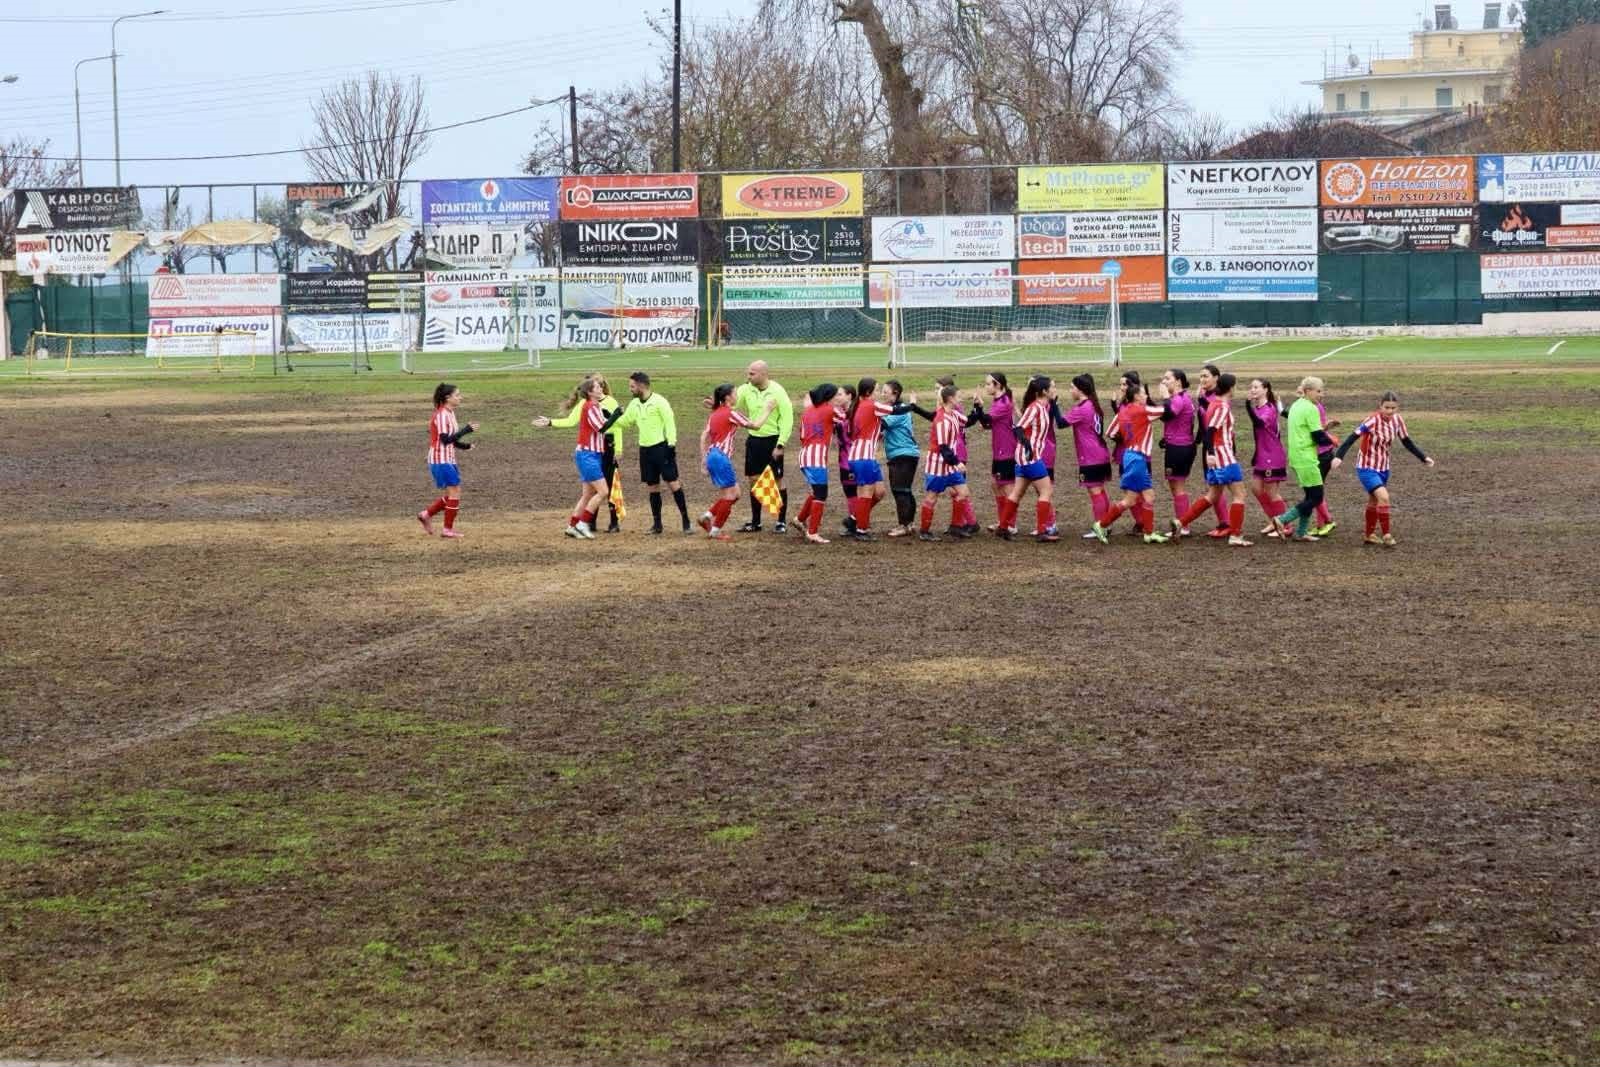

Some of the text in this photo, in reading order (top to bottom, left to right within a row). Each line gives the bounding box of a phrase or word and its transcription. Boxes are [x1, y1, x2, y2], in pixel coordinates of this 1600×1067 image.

[1190, 166, 1314, 183] ΝΕΓΚΟΓΛΟΥ
[1370, 159, 1468, 180] Horizon
[1047, 170, 1151, 187] MrPhone.gr
[596, 190, 691, 200] ΔΙΑΚΡΟΤΗΜΑ
[752, 186, 836, 200] X-TREME
[1400, 192, 1425, 201] 2510
[1429, 192, 1468, 201] 223122
[499, 201, 550, 212] ΔΗΜΗΤΡΗΣ
[1323, 209, 1365, 222] EVAN
[1395, 208, 1473, 218] ΜΠΑΞΕΒΑΝΙΔΗ
[578, 222, 678, 241] INIKON
[46, 234, 111, 253] ΤΟΥΝΟΥΣ
[580, 243, 679, 253] ΕΜΠΟΡΙΑ ΣΙΔΗΡΟΥ
[725, 225, 820, 261] Prestige
[1025, 241, 1064, 254] tech
[1097, 244, 1121, 253] 2510
[1123, 243, 1141, 251] 600
[1143, 243, 1161, 251] 311
[1194, 261, 1315, 272] Χ.Β. ΞΑΝΘΟΠΟΥΛΟΥ
[1485, 255, 1540, 266] ΓΕΩΡΓΙΟΣ
[651, 271, 693, 283] ΑΝΤΩΝΗΣ
[1489, 268, 1549, 279] ΣΥΝΕΡΓΕΙΟ
[1023, 272, 1107, 288] welcome
[1518, 279, 1597, 289] ΠΑΝΤΟΣ ΤΥΠΟΥ
[636, 296, 693, 306] 2510 831100
[455, 314, 556, 335] ISAAKDIS
